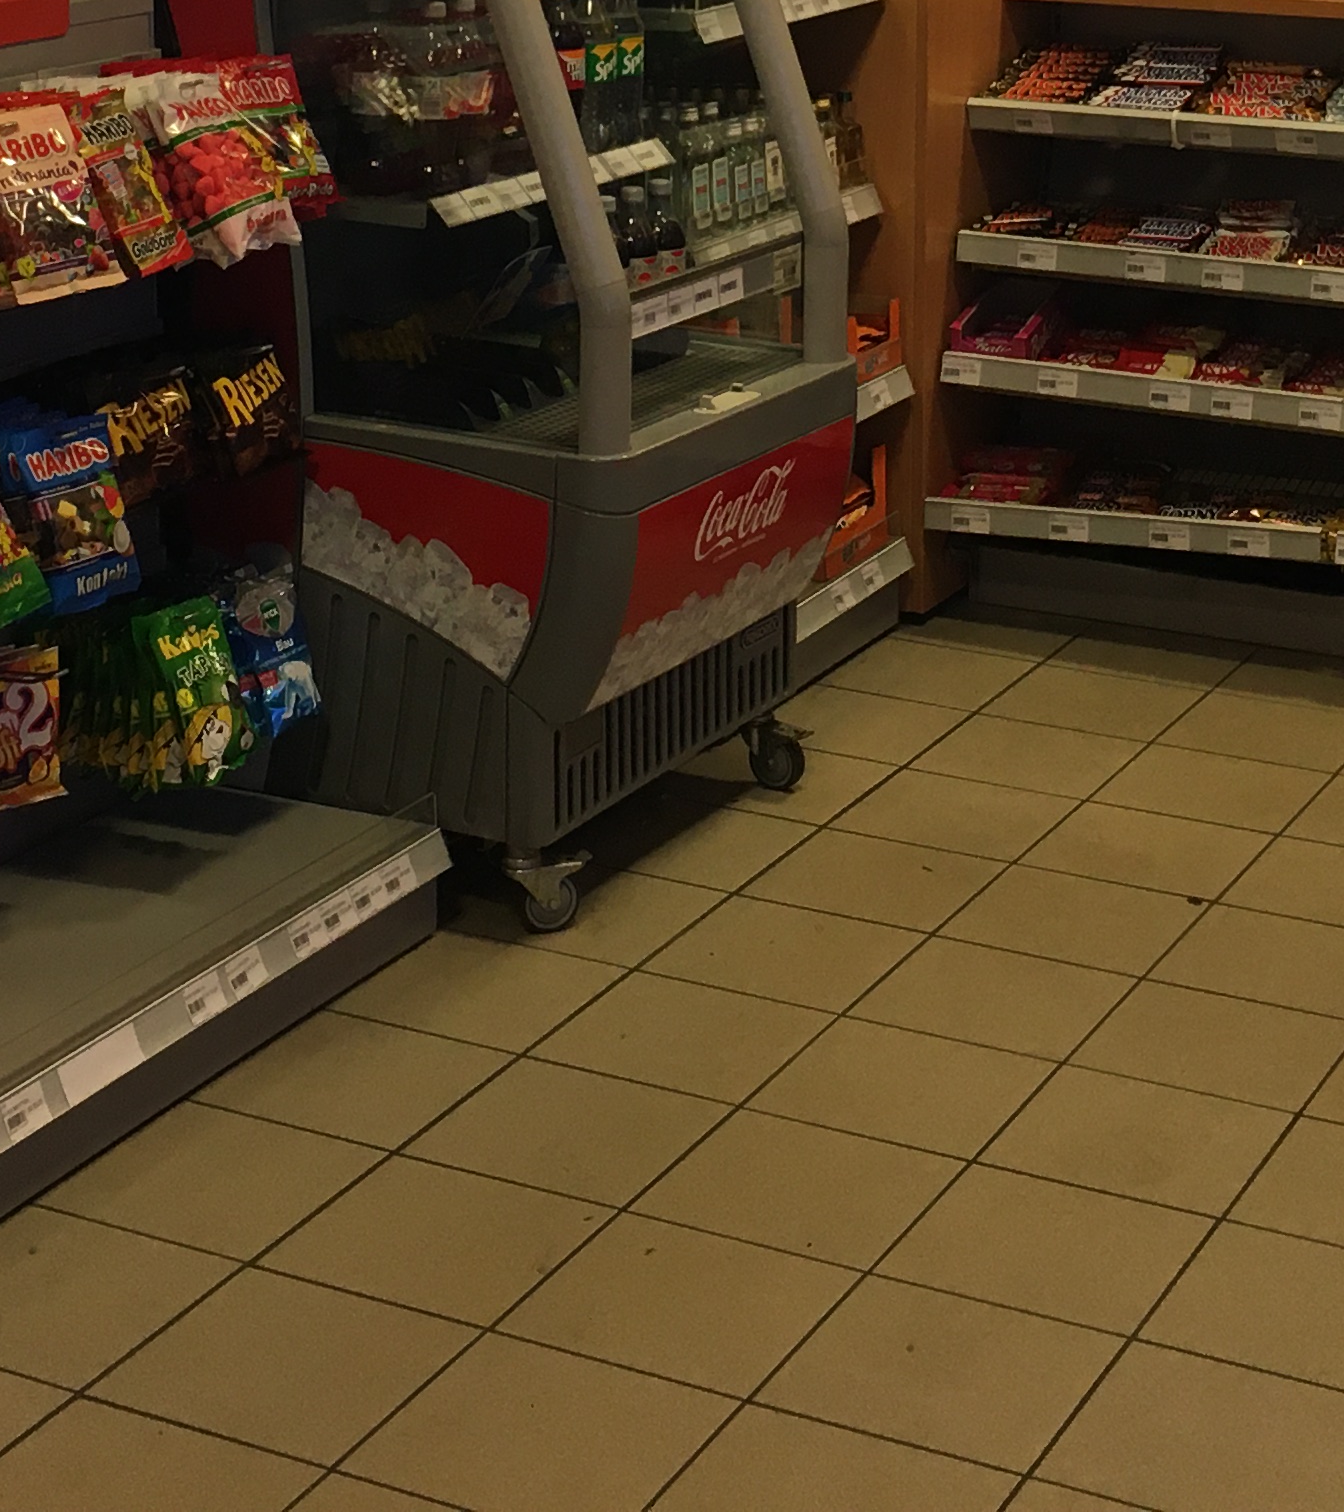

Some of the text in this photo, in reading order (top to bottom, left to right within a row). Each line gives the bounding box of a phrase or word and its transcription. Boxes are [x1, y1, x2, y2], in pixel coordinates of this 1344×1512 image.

[80, 114, 134, 146] HARIBO
[107, 381, 192, 457] RIESEN
[212, 352, 287, 428] RIESEN
[27, 438, 111, 482] HARIBO
[693, 458, 795, 561] Coca-Cola
[76, 561, 128, 596] Konfekt
